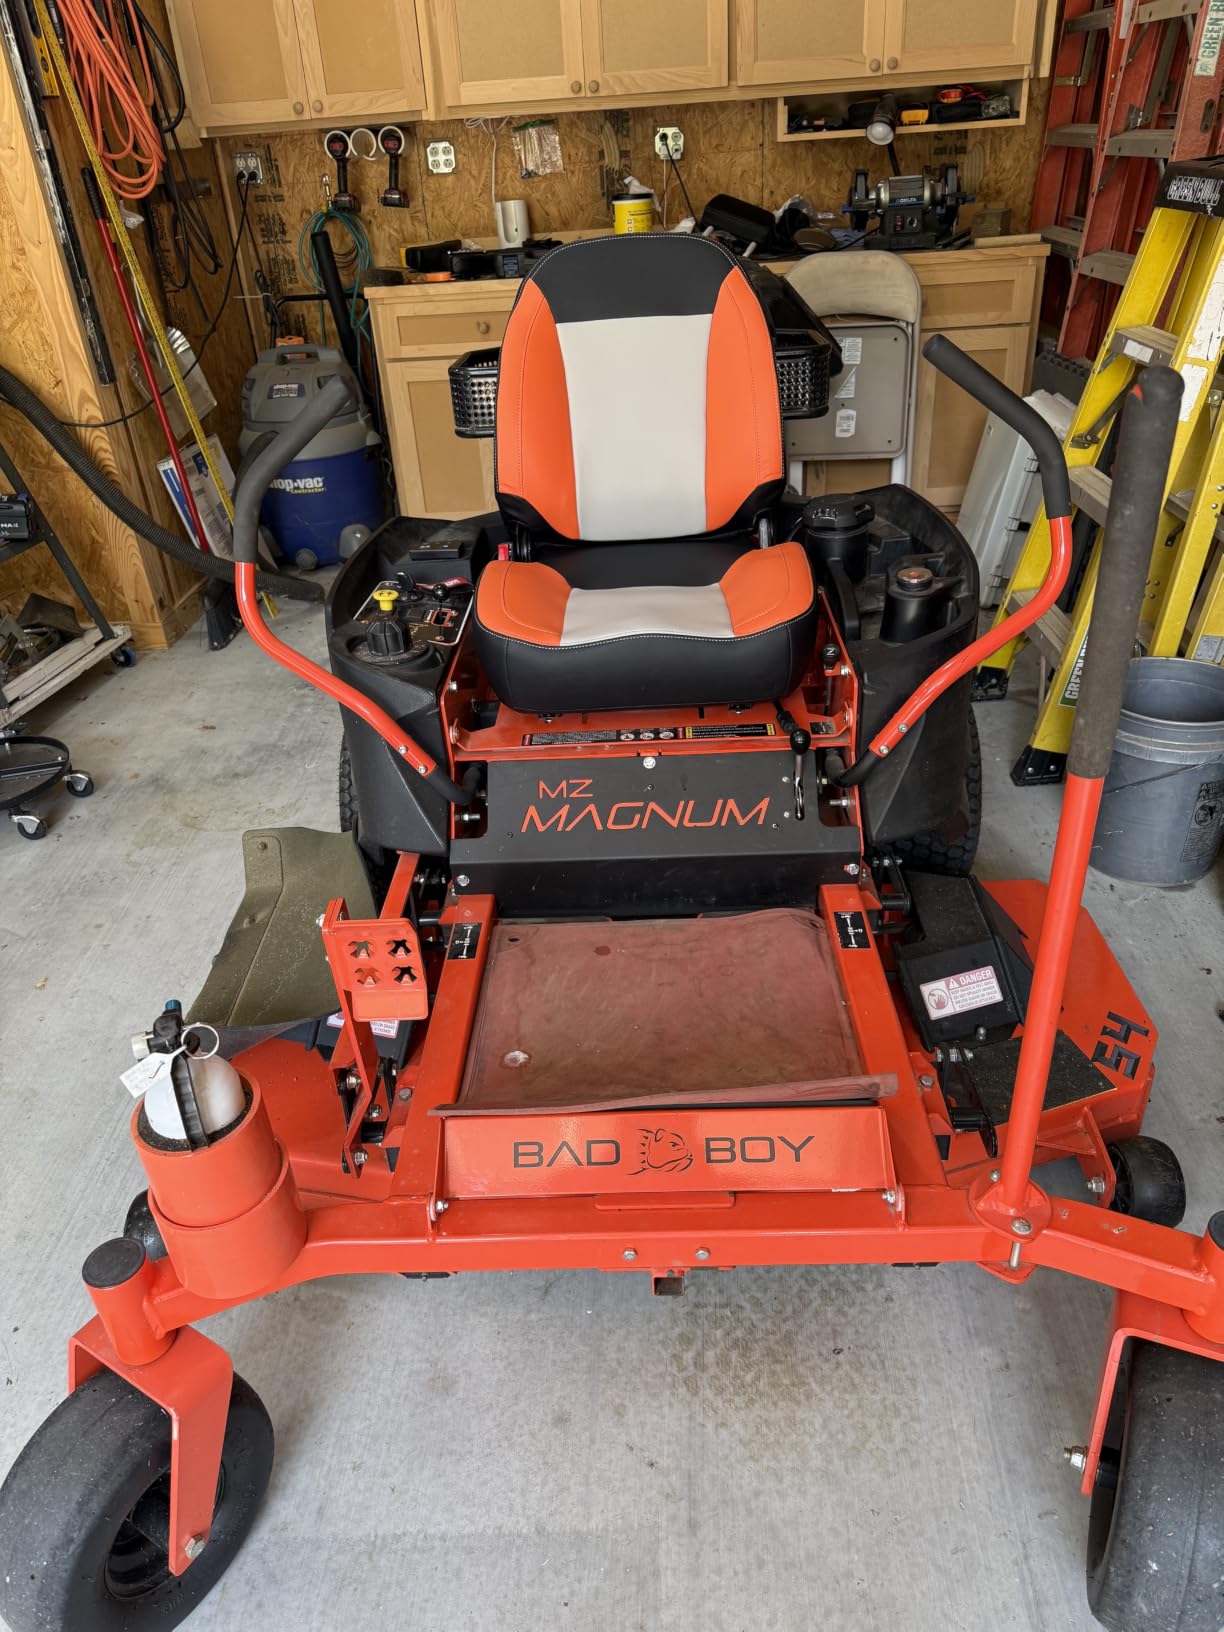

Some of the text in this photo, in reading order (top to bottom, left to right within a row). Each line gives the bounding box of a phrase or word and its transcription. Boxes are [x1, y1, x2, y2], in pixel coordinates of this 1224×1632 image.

[538, 778, 594, 799] MZ
[520, 797, 770, 833] MAGNUM
[959, 969, 993, 985] DANGER
[1091, 1010, 1150, 1081] 54
[512, 1135, 816, 1168] BAD BOY
